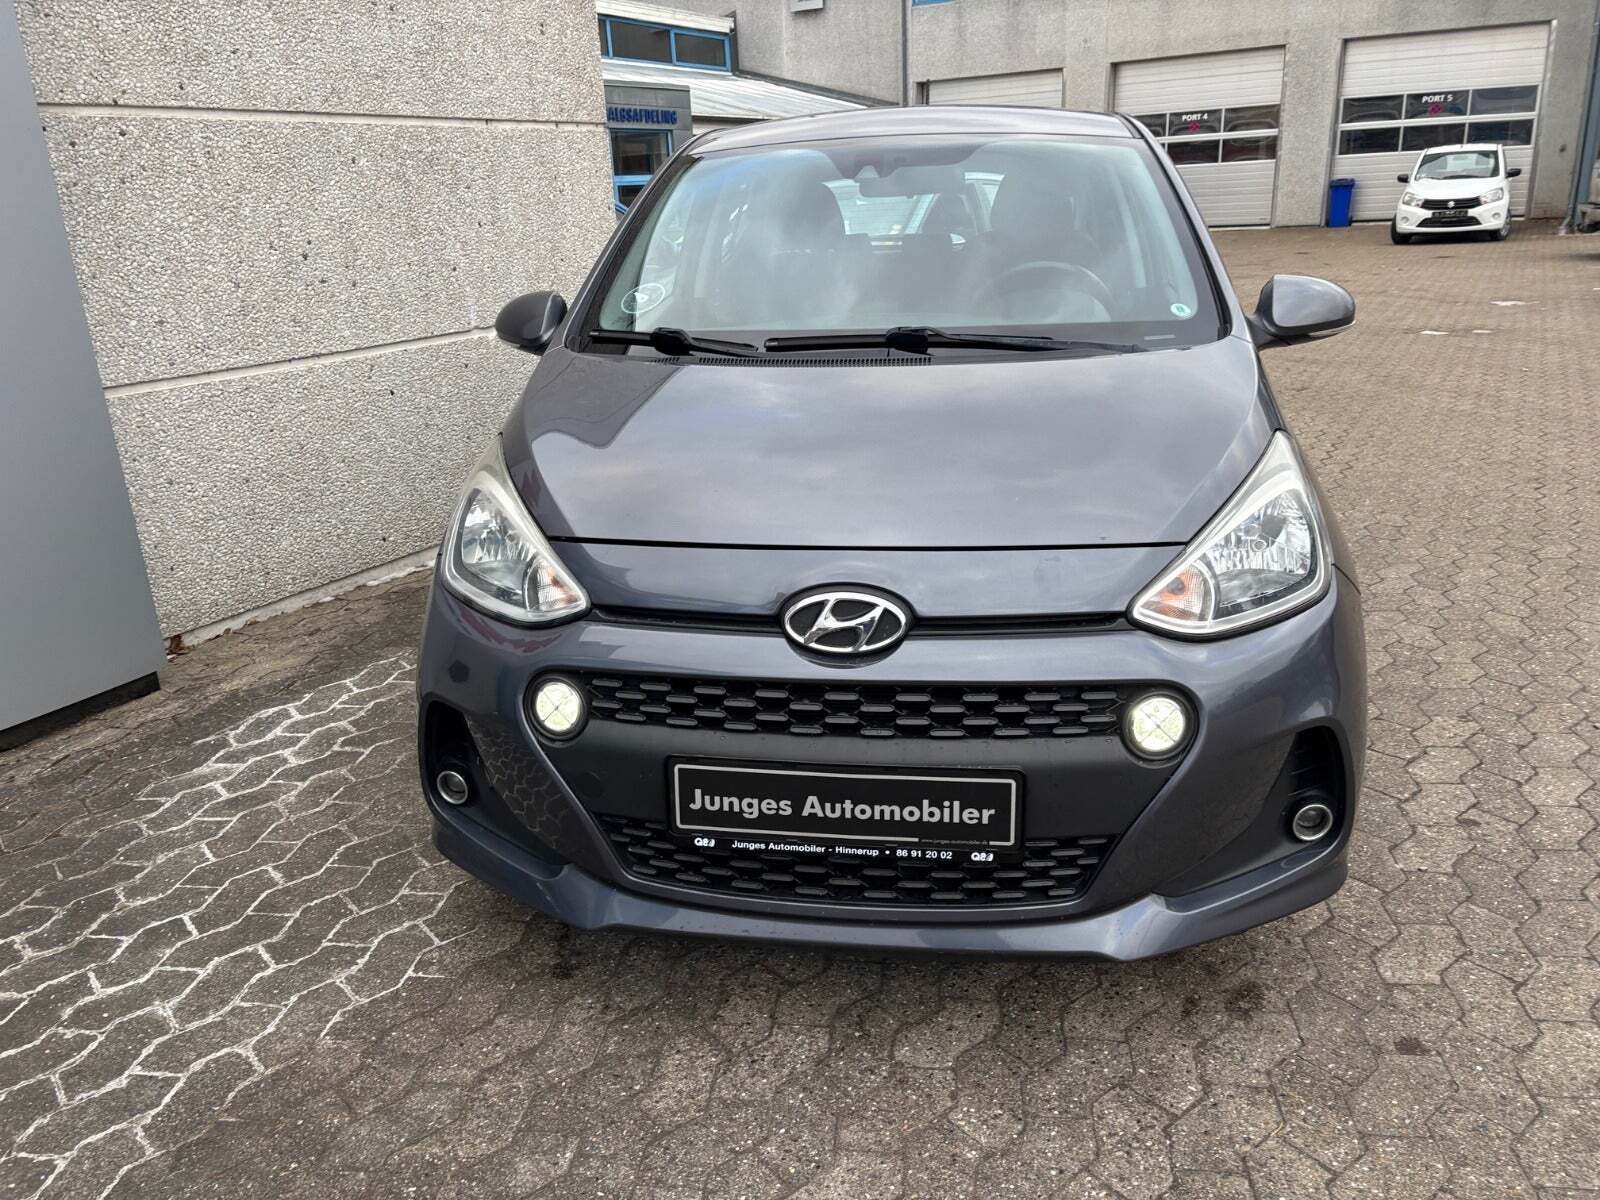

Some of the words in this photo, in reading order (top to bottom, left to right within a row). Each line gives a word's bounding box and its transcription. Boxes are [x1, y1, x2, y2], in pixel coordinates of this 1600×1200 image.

[1422, 95, 1446, 103] PORT
[1181, 113, 1202, 122] PORT
[1202, 112, 1209, 120] 4
[689, 788, 793, 819] Junges
[801, 795, 996, 825] Automobiler
[732, 840, 766, 850] Junges
[768, 842, 826, 853] Automobiler
[835, 846, 879, 857] Hinnerup
[896, 849, 908, 857] 86
[911, 850, 922, 858] 91
[925, 850, 938, 859] 20
[940, 851, 953, 860] 02
